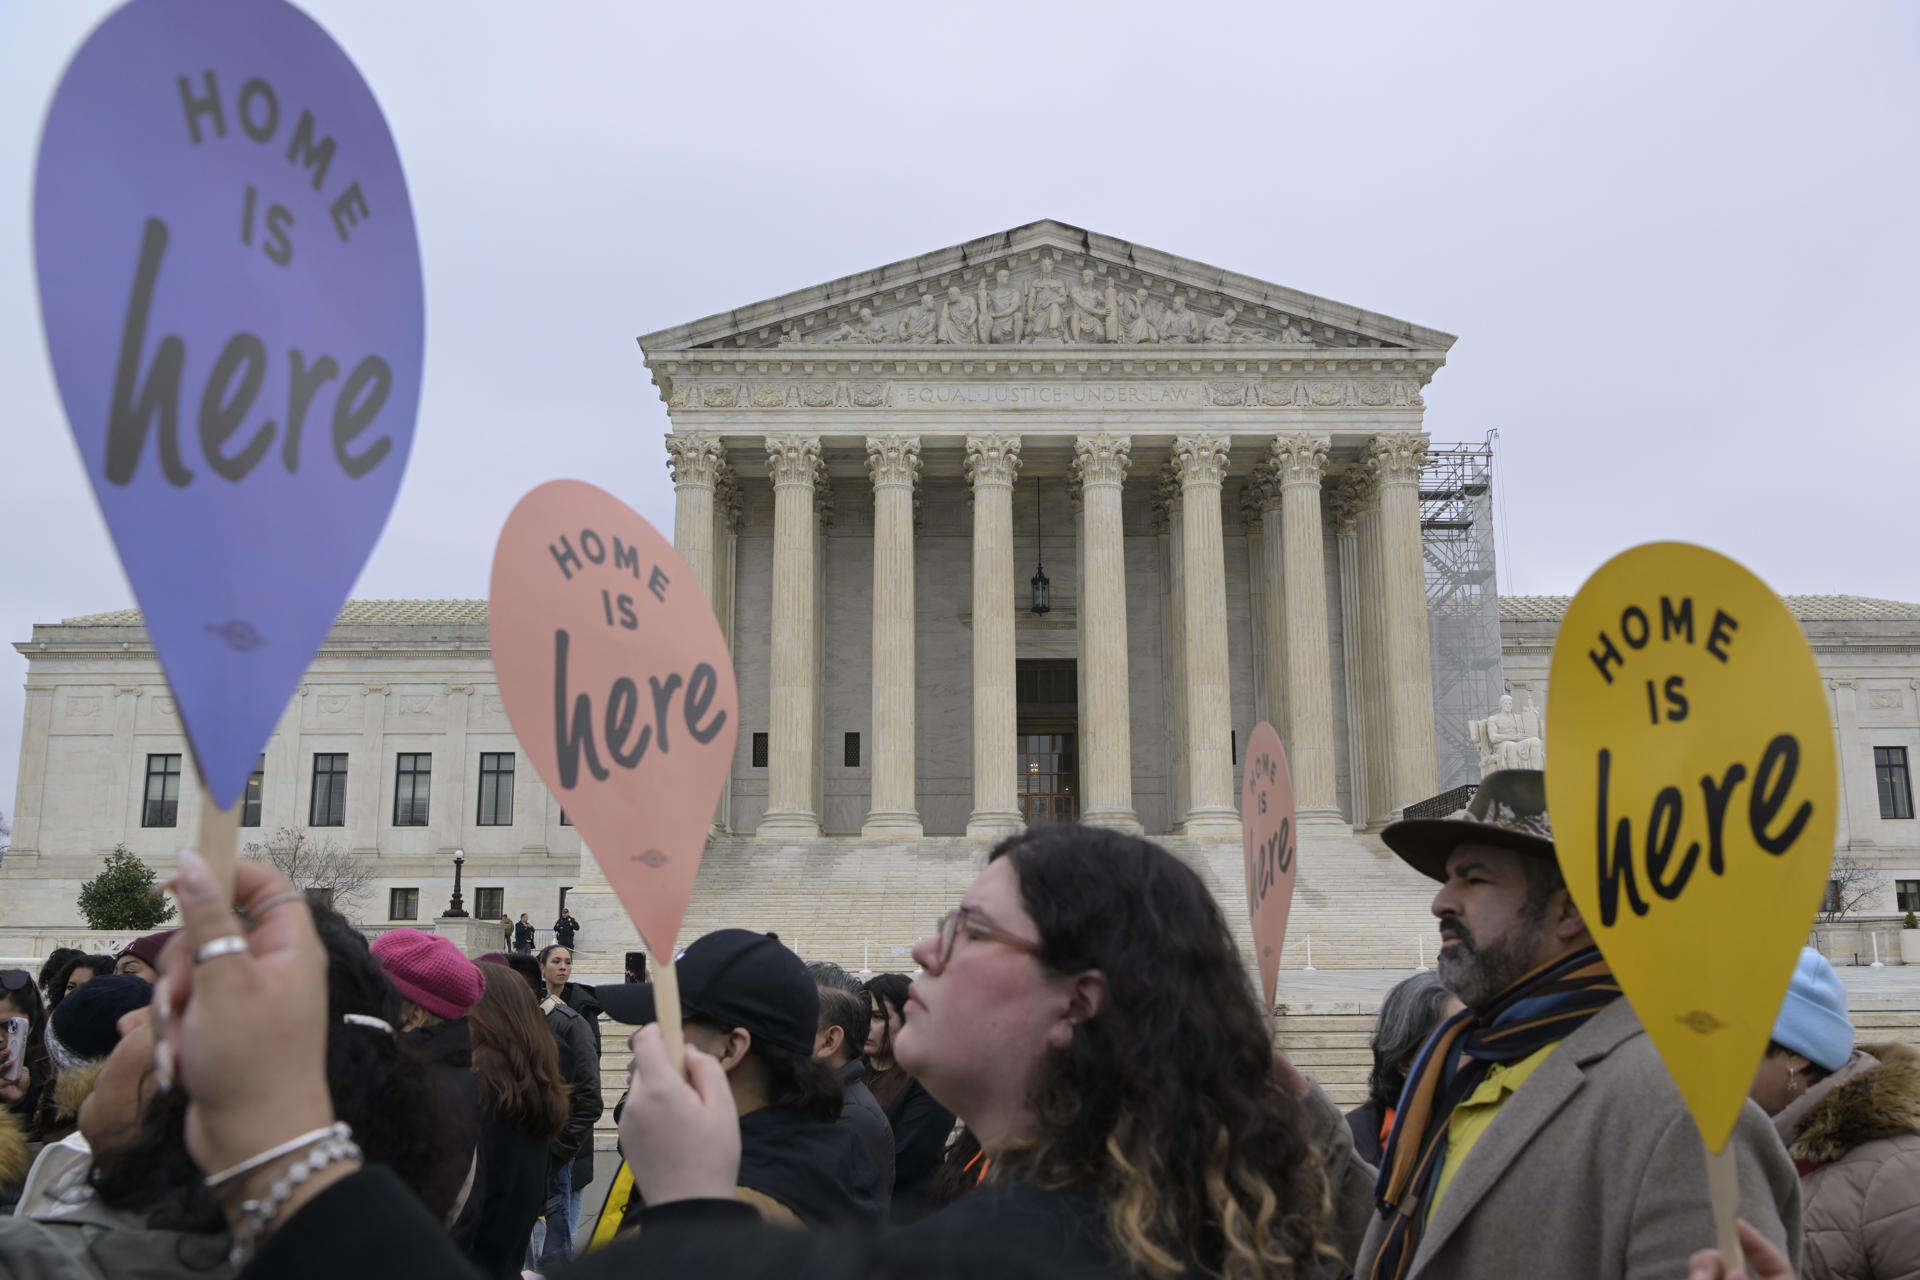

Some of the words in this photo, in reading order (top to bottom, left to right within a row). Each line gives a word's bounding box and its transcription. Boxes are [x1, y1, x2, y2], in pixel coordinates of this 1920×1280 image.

[178, 68, 370, 244] HOME
[240, 184, 295, 268] IS
[104, 216, 393, 488] here
[906, 386, 976, 403] EQUAL
[983, 385, 1062, 403] JUSTICE
[1072, 385, 1142, 402] UNDER
[1149, 385, 1189, 402] LAW
[548, 529, 671, 602] HOME
[602, 590, 639, 631] IS
[1588, 596, 1739, 685] HOME
[554, 629, 727, 791] here
[1646, 675, 1689, 725] IS
[1249, 754, 1277, 796] HOME
[1257, 791, 1267, 816] IS
[1249, 817, 1293, 918] here
[1596, 733, 1814, 928] here
